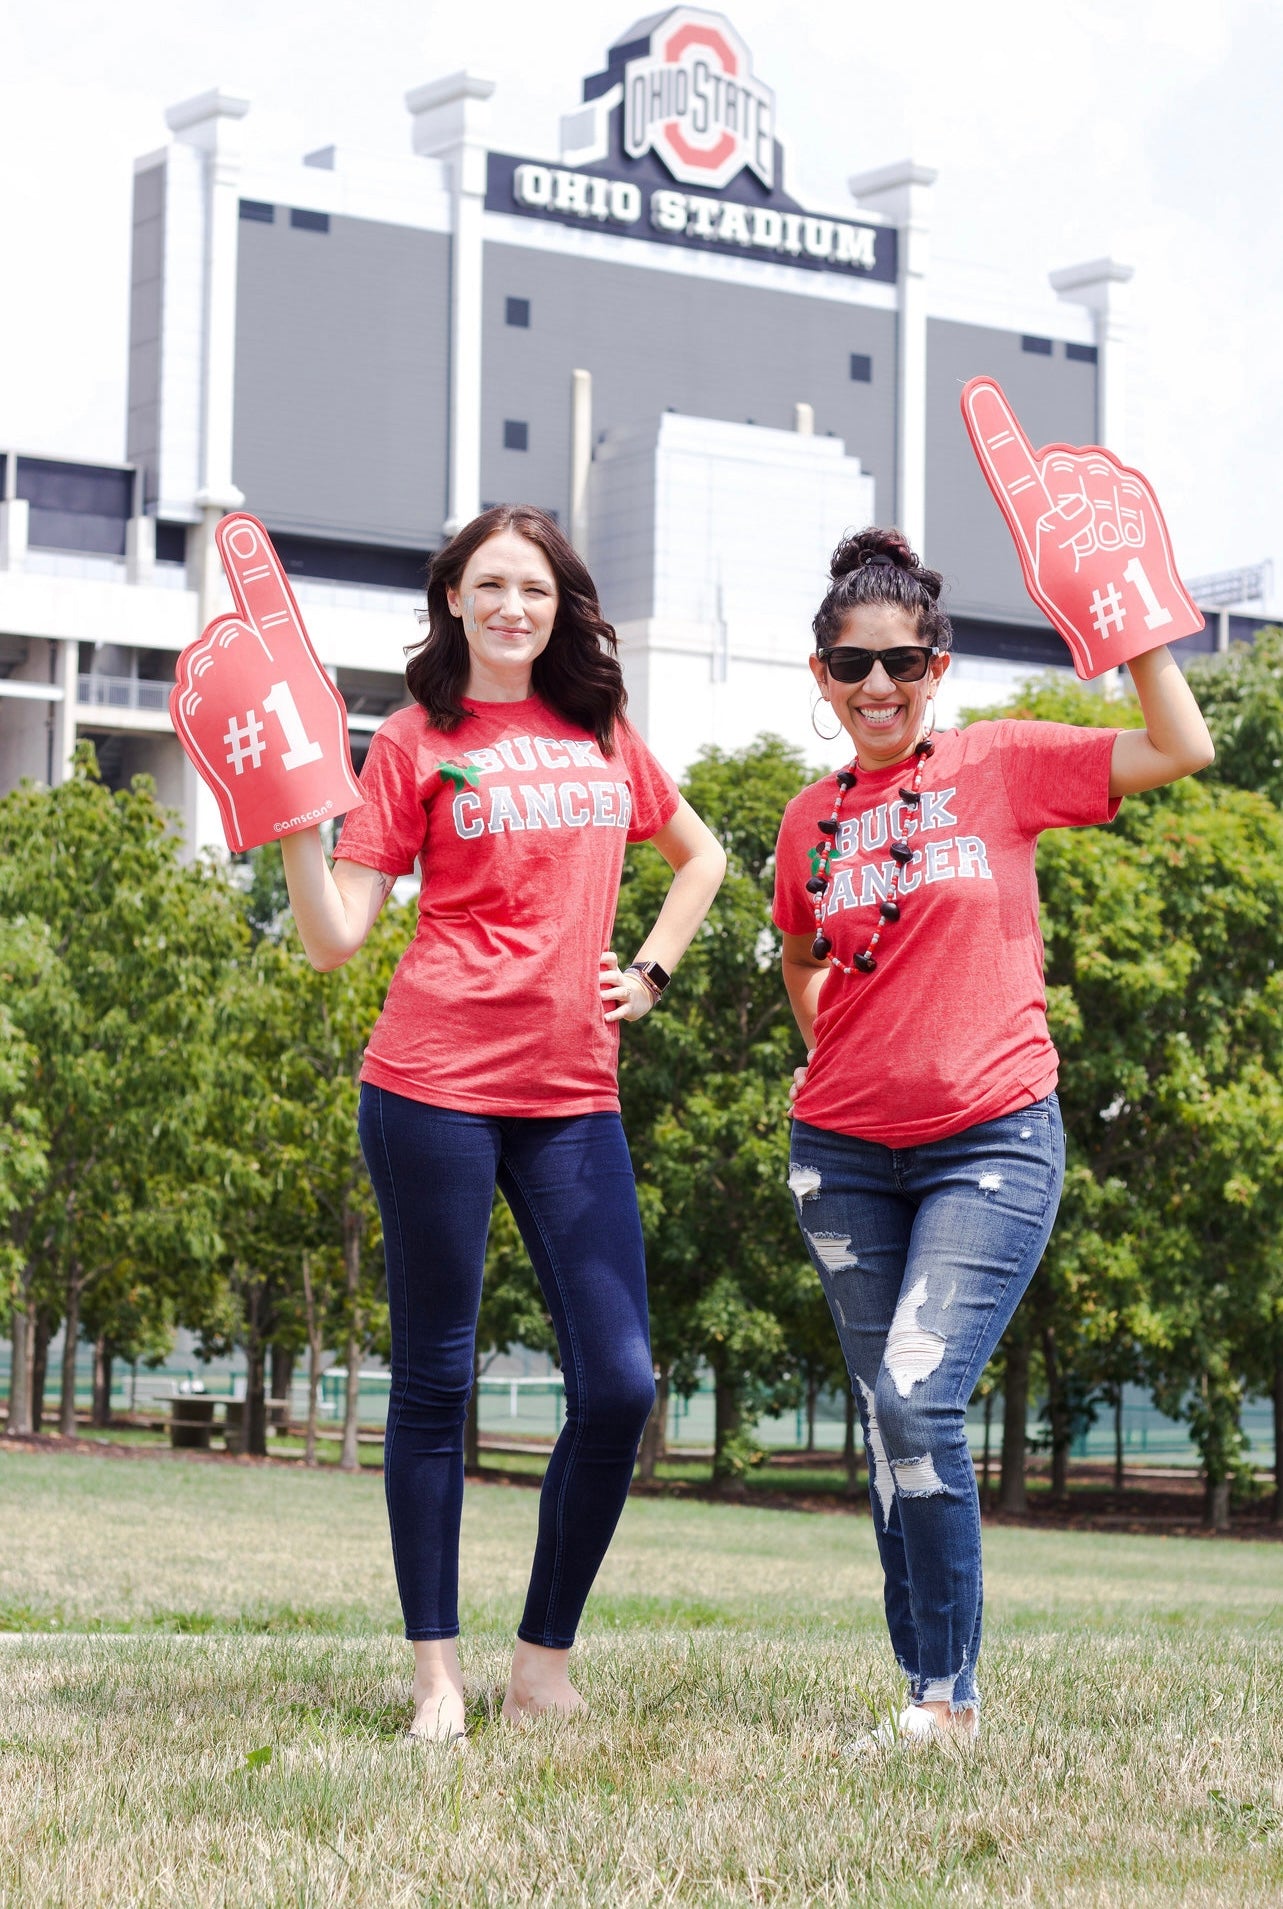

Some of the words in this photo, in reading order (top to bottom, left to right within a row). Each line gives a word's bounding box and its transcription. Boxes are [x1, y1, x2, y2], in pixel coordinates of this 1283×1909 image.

[632, 68, 688, 149] OHIO
[693, 60, 771, 174] STATE
[514, 164, 641, 222] OHIO
[651, 190, 876, 270] STADIUM
[1089, 557, 1173, 640] #1
[223, 680, 324, 776] #1
[464, 735, 608, 775] BUCK
[832, 787, 958, 862] BUCK
[814, 835, 993, 923] ANCER
